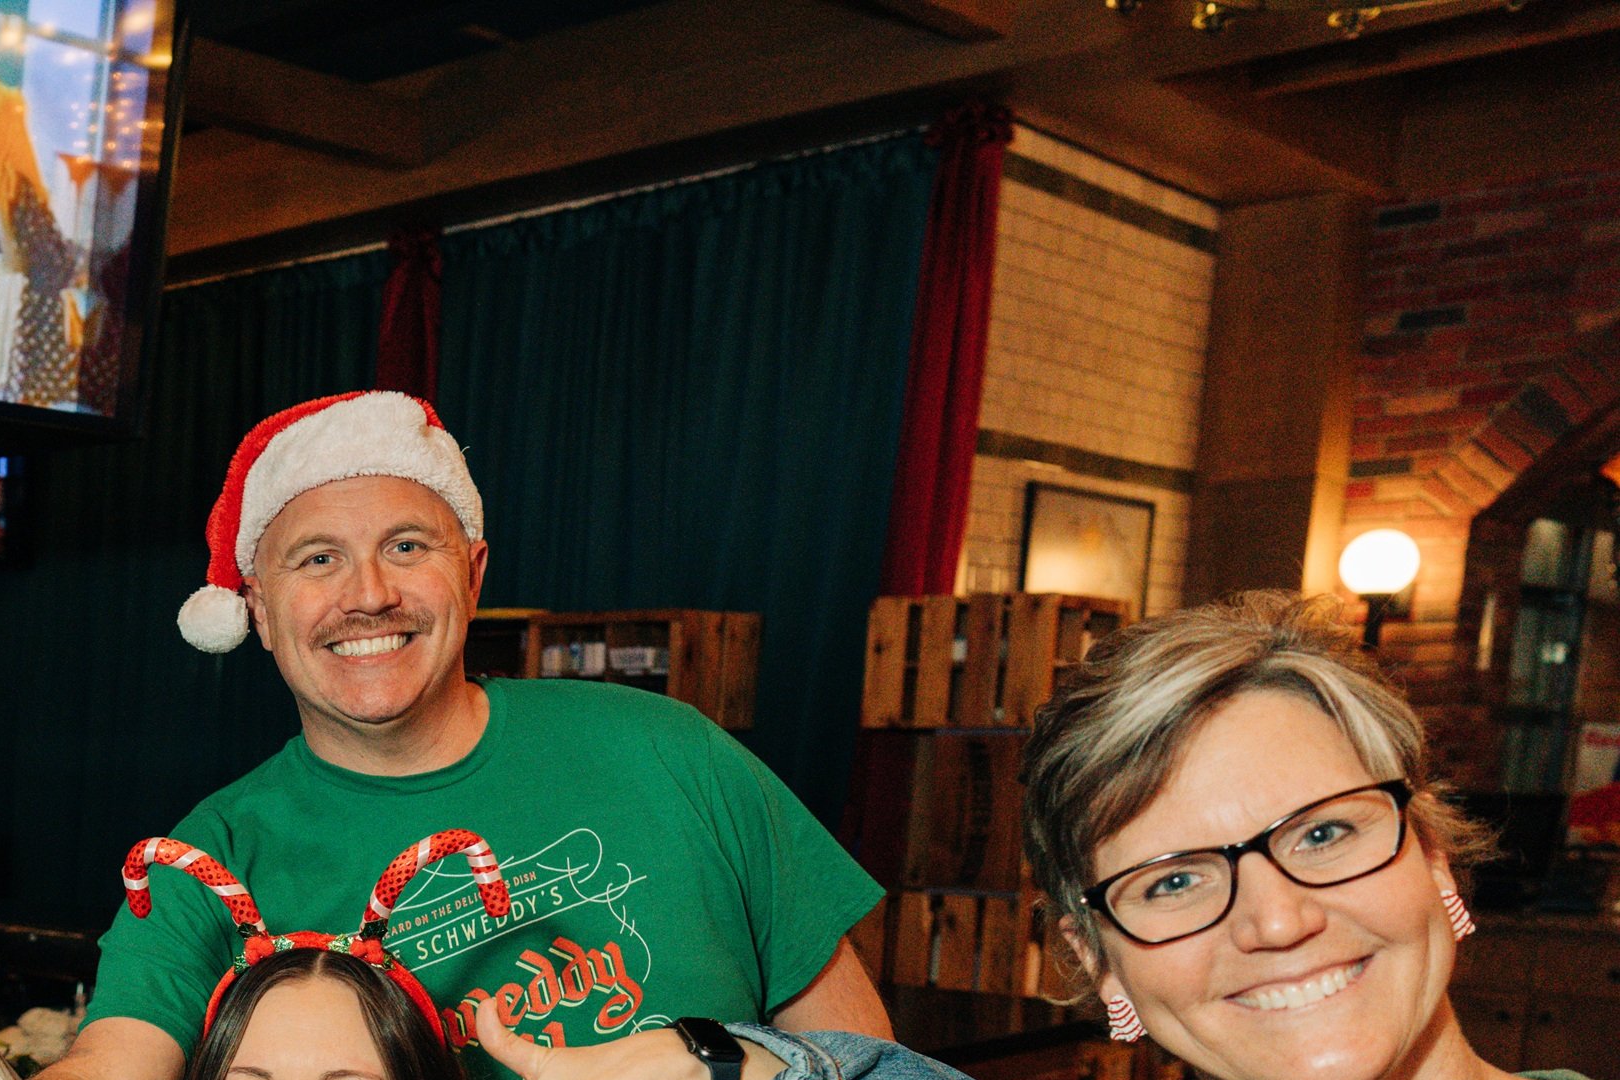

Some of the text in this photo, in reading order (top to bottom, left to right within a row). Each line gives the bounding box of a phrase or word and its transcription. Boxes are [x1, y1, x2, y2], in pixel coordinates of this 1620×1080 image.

[415, 913, 429, 926] ON
[431, 902, 452, 920] THE
[513, 871, 537, 888] DISH
